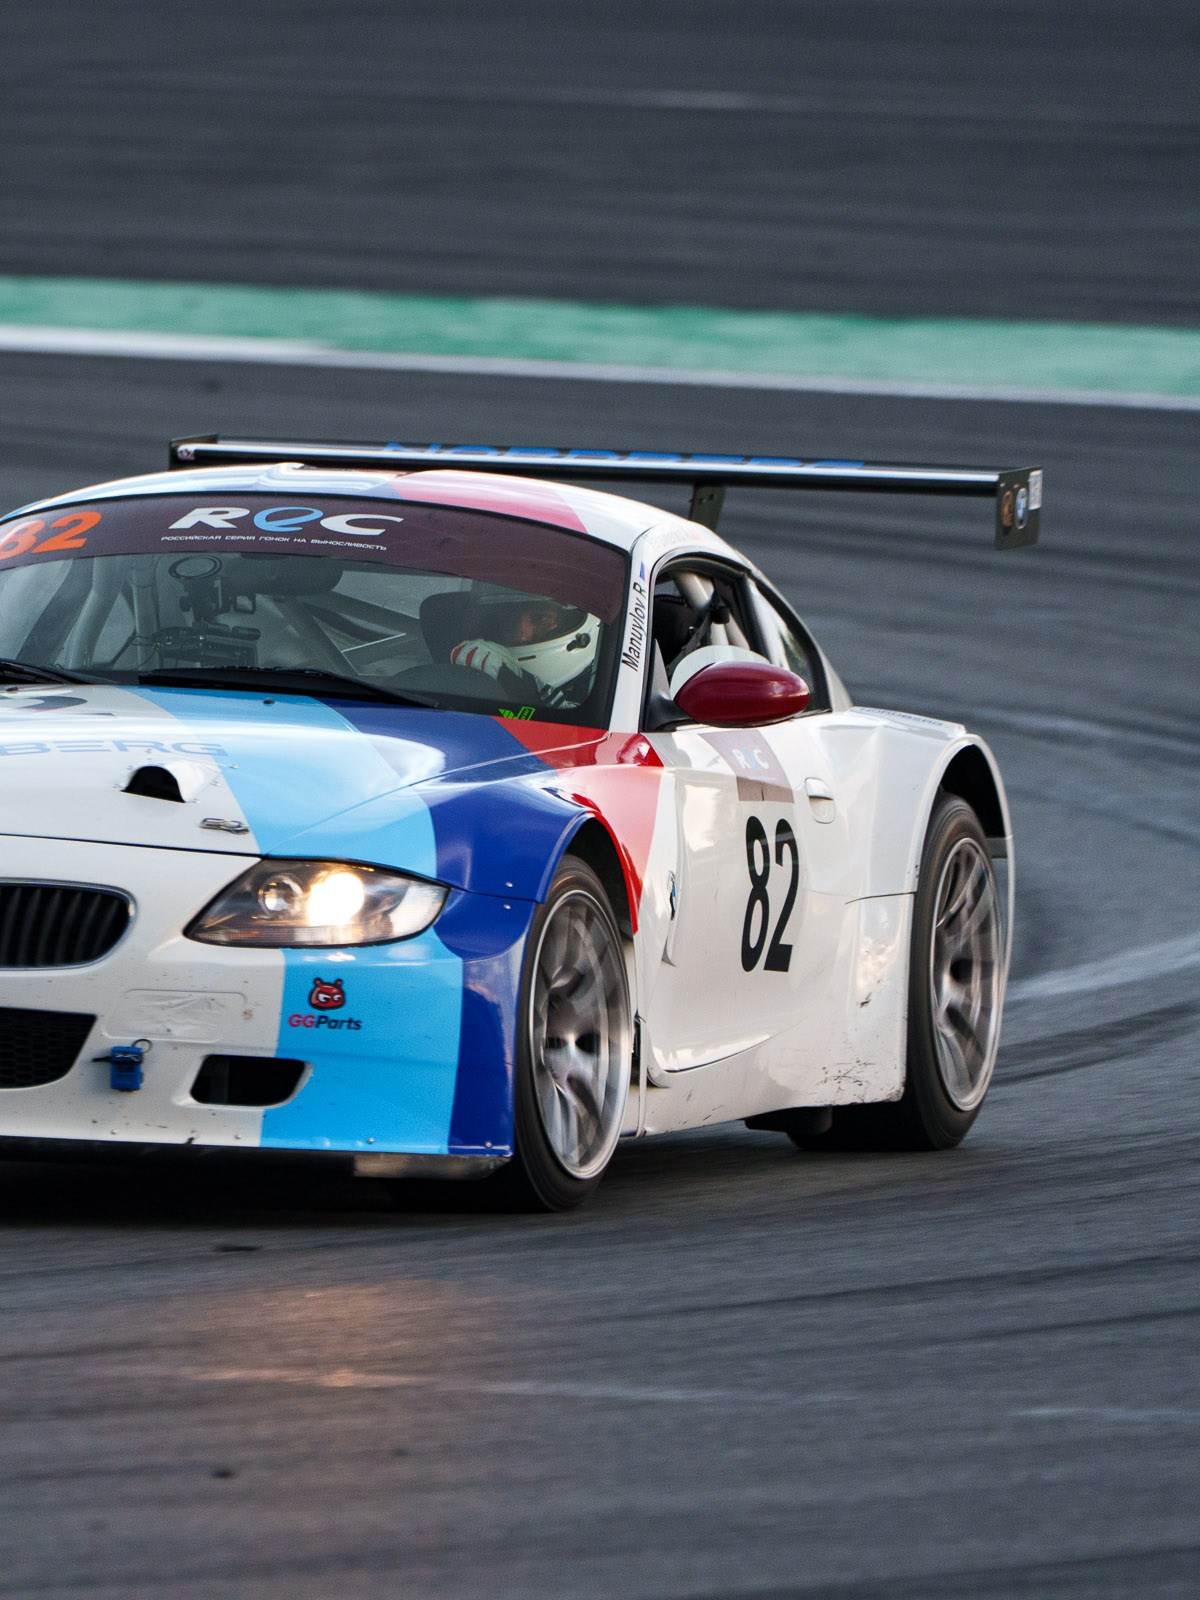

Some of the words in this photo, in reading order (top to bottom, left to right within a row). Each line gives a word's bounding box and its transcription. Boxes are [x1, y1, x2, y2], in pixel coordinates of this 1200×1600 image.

[160, 534, 222, 542] РОССИЙСКАЯ
[224, 534, 256, 542] СЕРИЯ
[258, 535, 290, 543] ГОНОК
[310, 538, 388, 551] ВЫНОСЛИВОСТЬ
[740, 815, 800, 973] 82
[287, 1013, 363, 1031] GGParts
